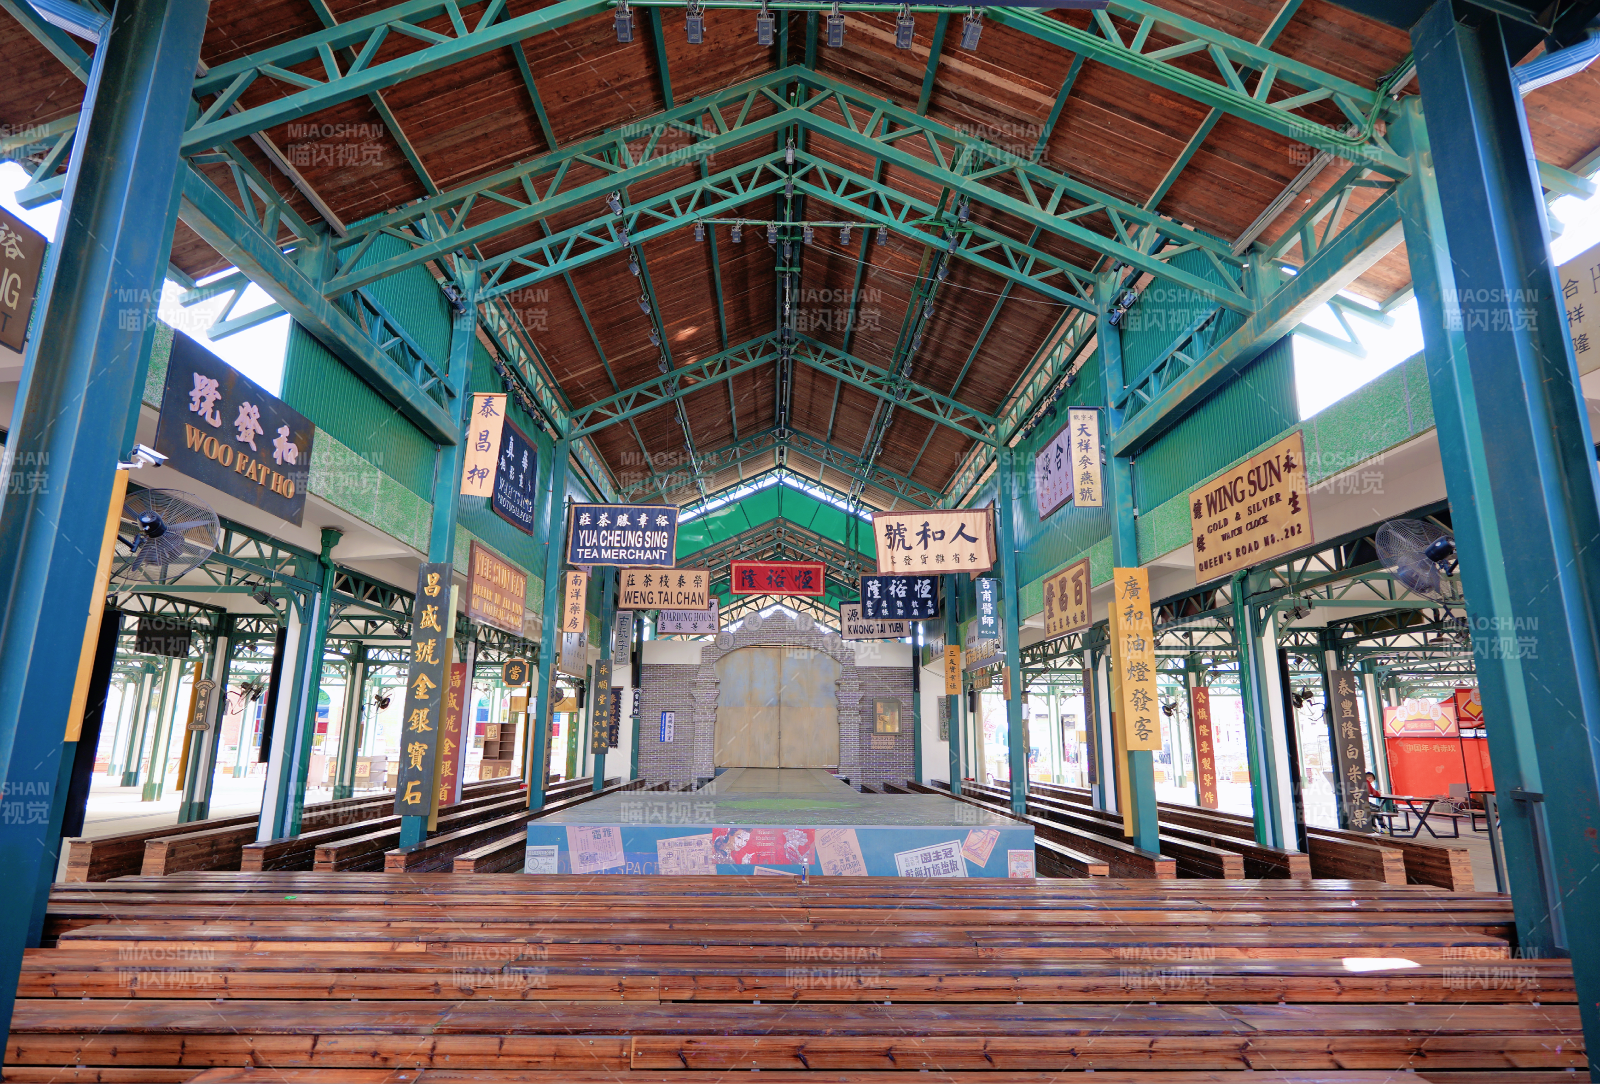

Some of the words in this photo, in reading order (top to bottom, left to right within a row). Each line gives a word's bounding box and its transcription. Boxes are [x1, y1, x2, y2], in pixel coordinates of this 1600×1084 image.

[466, 396, 500, 489] 泰昌押
[185, 423, 233, 467] WOO
[235, 451, 270, 487] FAT
[271, 471, 296, 498] HO
[1205, 475, 1245, 517] WING
[1247, 455, 1282, 497] SUN
[1207, 518, 1228, 534] GOLD
[1235, 512, 1241, 521] &
[1248, 493, 1282, 515] SILVER
[1221, 526, 1242, 541] WATCH
[1246, 515, 1269, 531] CLOCK
[577, 549, 599, 558] TEA
[601, 549, 667, 560] MERCHANT
[579, 530, 598, 546] YUA
[600, 530, 642, 547] CHEUNG
[644, 531, 668, 548] SING
[1236, 541, 1259, 557] ROAD
[475, 550, 492, 581] YEE
[510, 571, 525, 599] FAT
[567, 574, 582, 629] 南洋藥房
[694, 613, 715, 622] HOUSE
[847, 623, 873, 634] KWONG
[876, 623, 886, 633] TAI
[888, 622, 904, 632] YUEN
[402, 573, 442, 805] 昌盛號金銀寶石
[509, 665, 521, 681] 當
